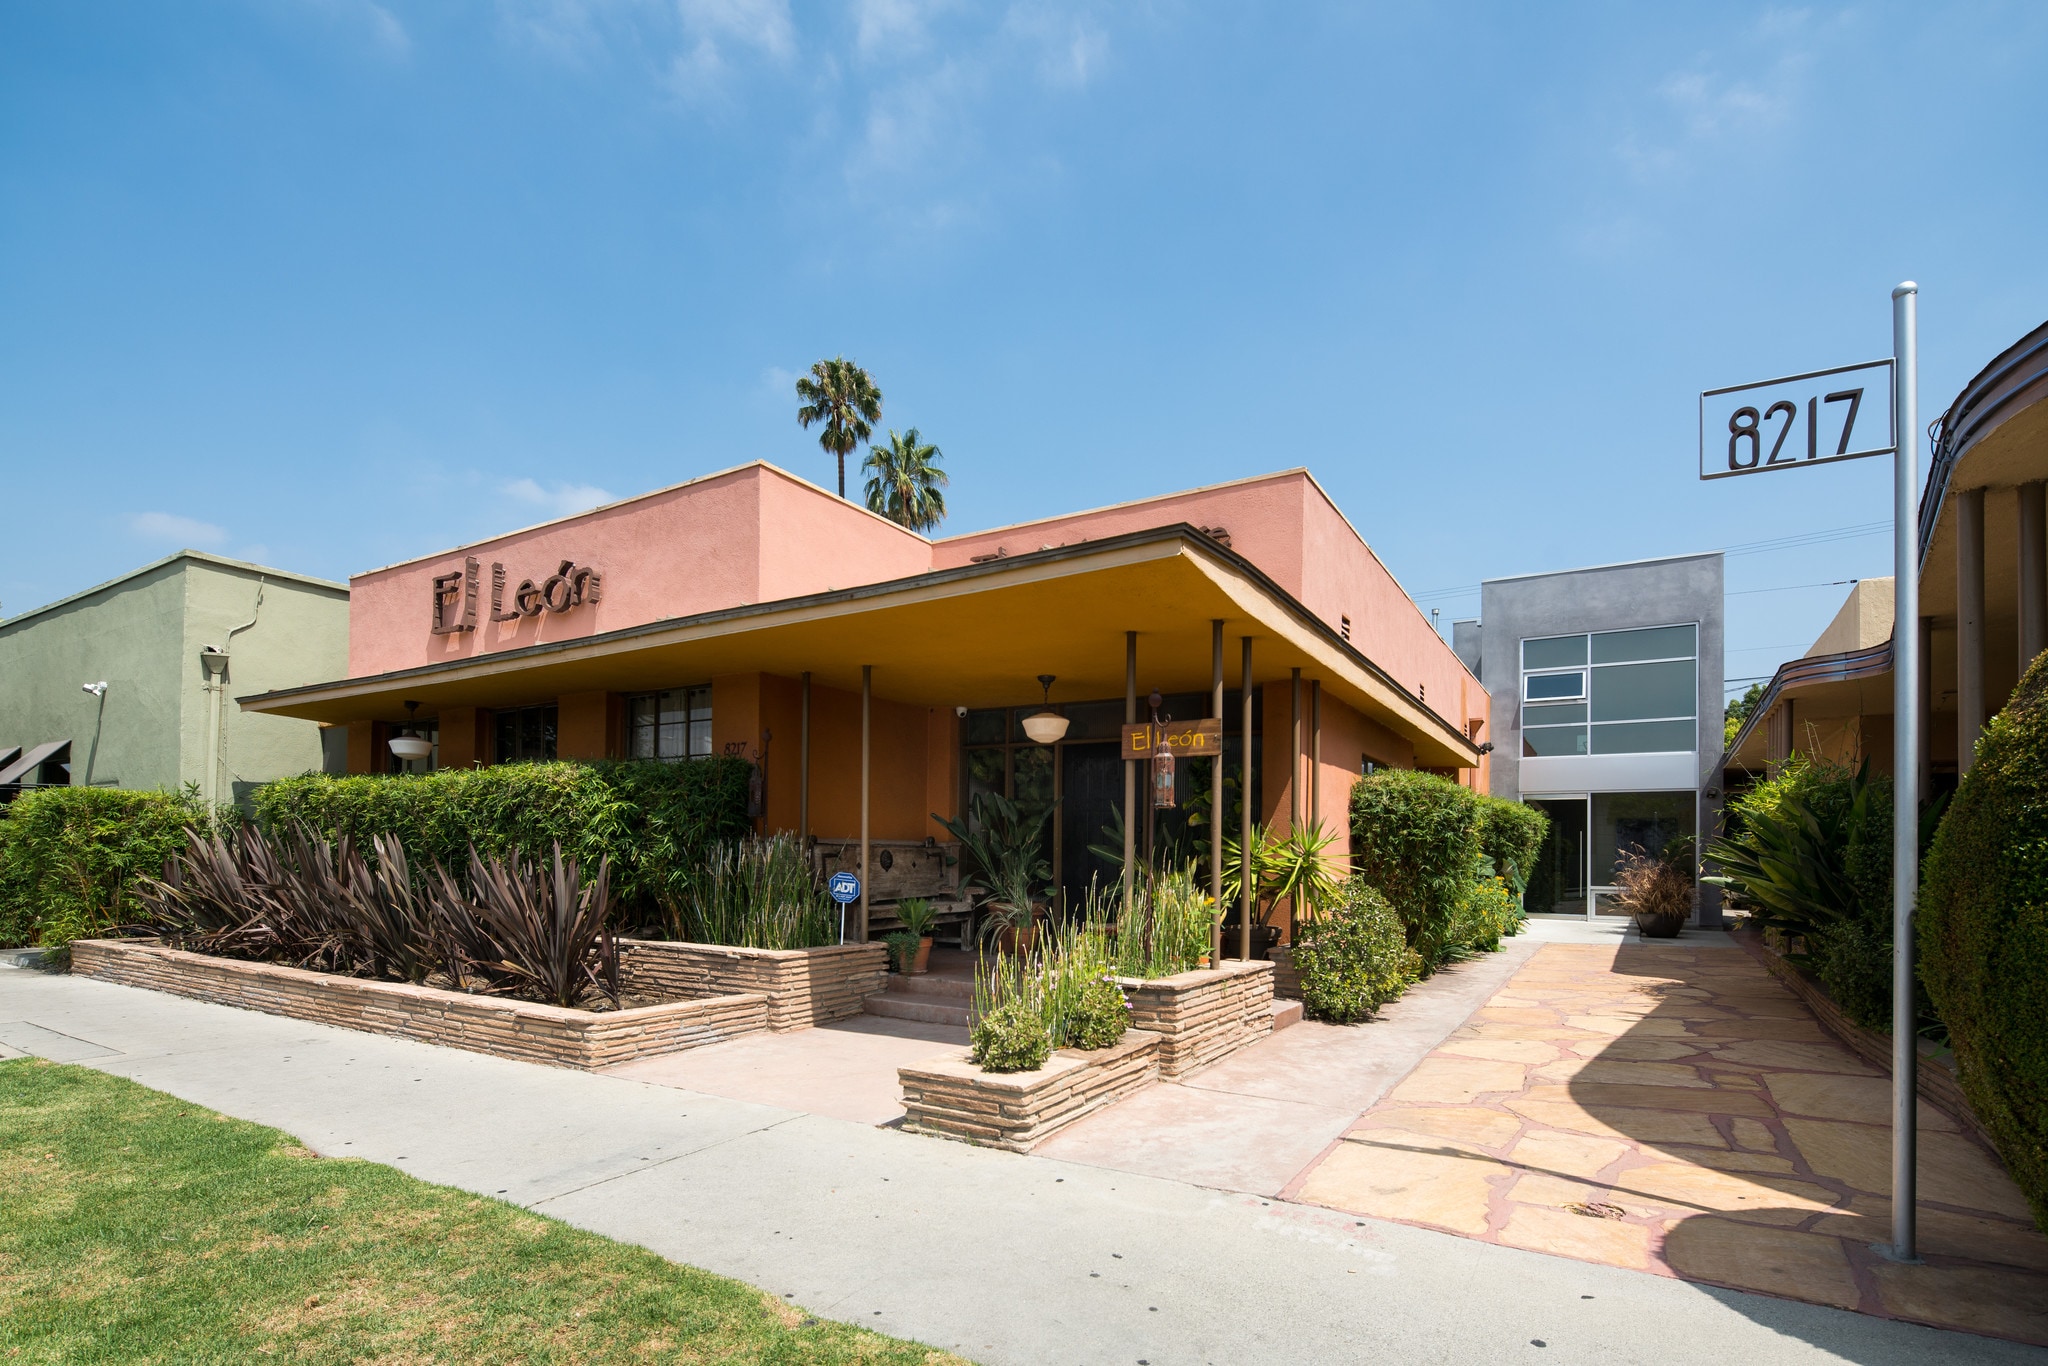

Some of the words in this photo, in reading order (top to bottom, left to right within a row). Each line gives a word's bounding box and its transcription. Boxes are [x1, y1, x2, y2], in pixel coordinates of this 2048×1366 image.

[1728, 387, 1865, 470] 8217
[431, 555, 479, 635] El
[724, 742, 748, 756] 8217
[1131, 725, 1151, 751] El
[834, 881, 856, 894] ADT
